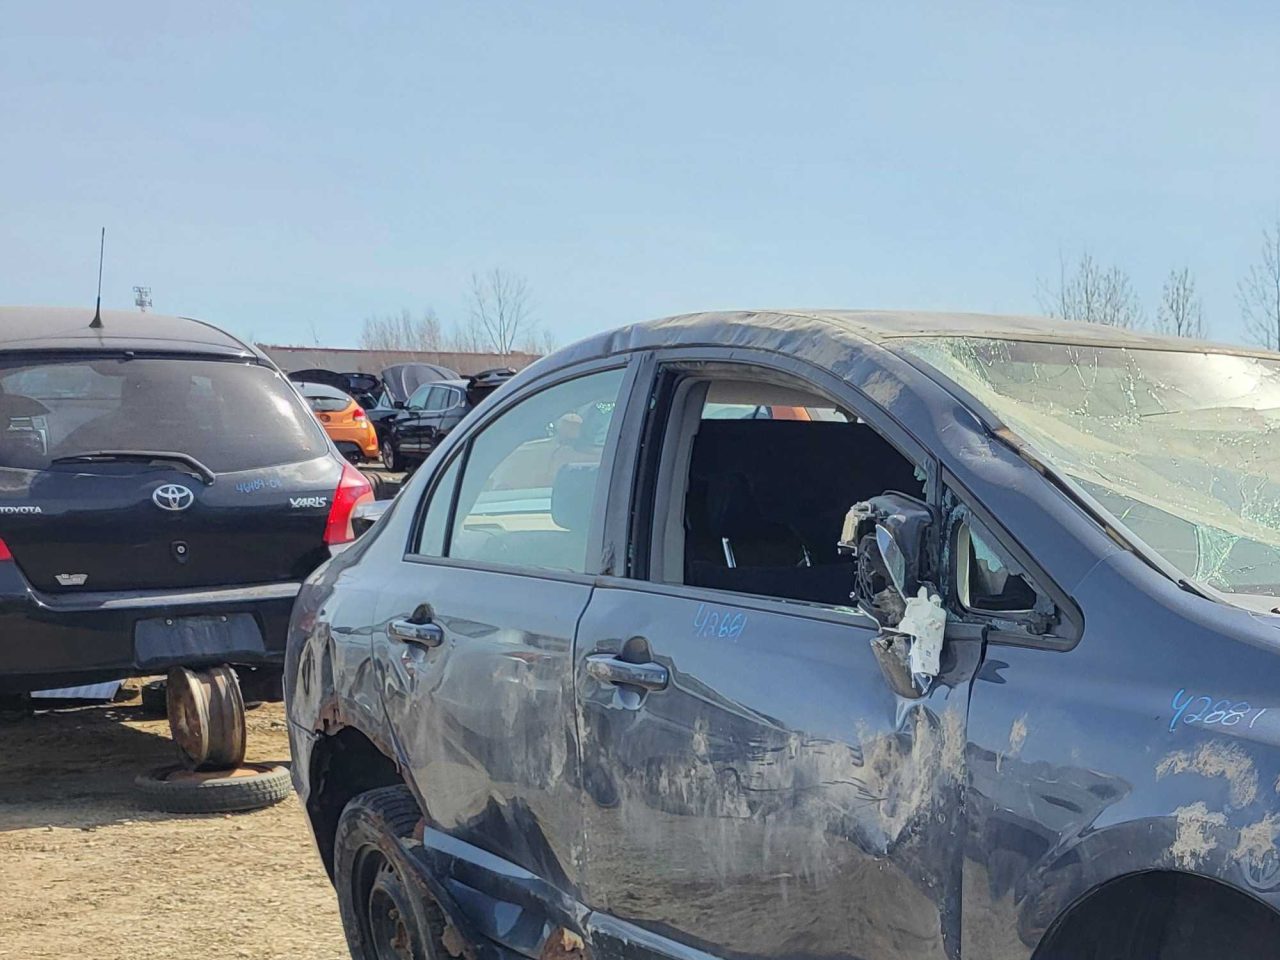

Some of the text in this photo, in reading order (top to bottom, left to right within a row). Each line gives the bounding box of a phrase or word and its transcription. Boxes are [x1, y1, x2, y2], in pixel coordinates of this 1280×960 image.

[290, 496, 327, 508] YARIS
[0, 506, 42, 514] TOYOTA
[1168, 689, 1266, 732] 42881
